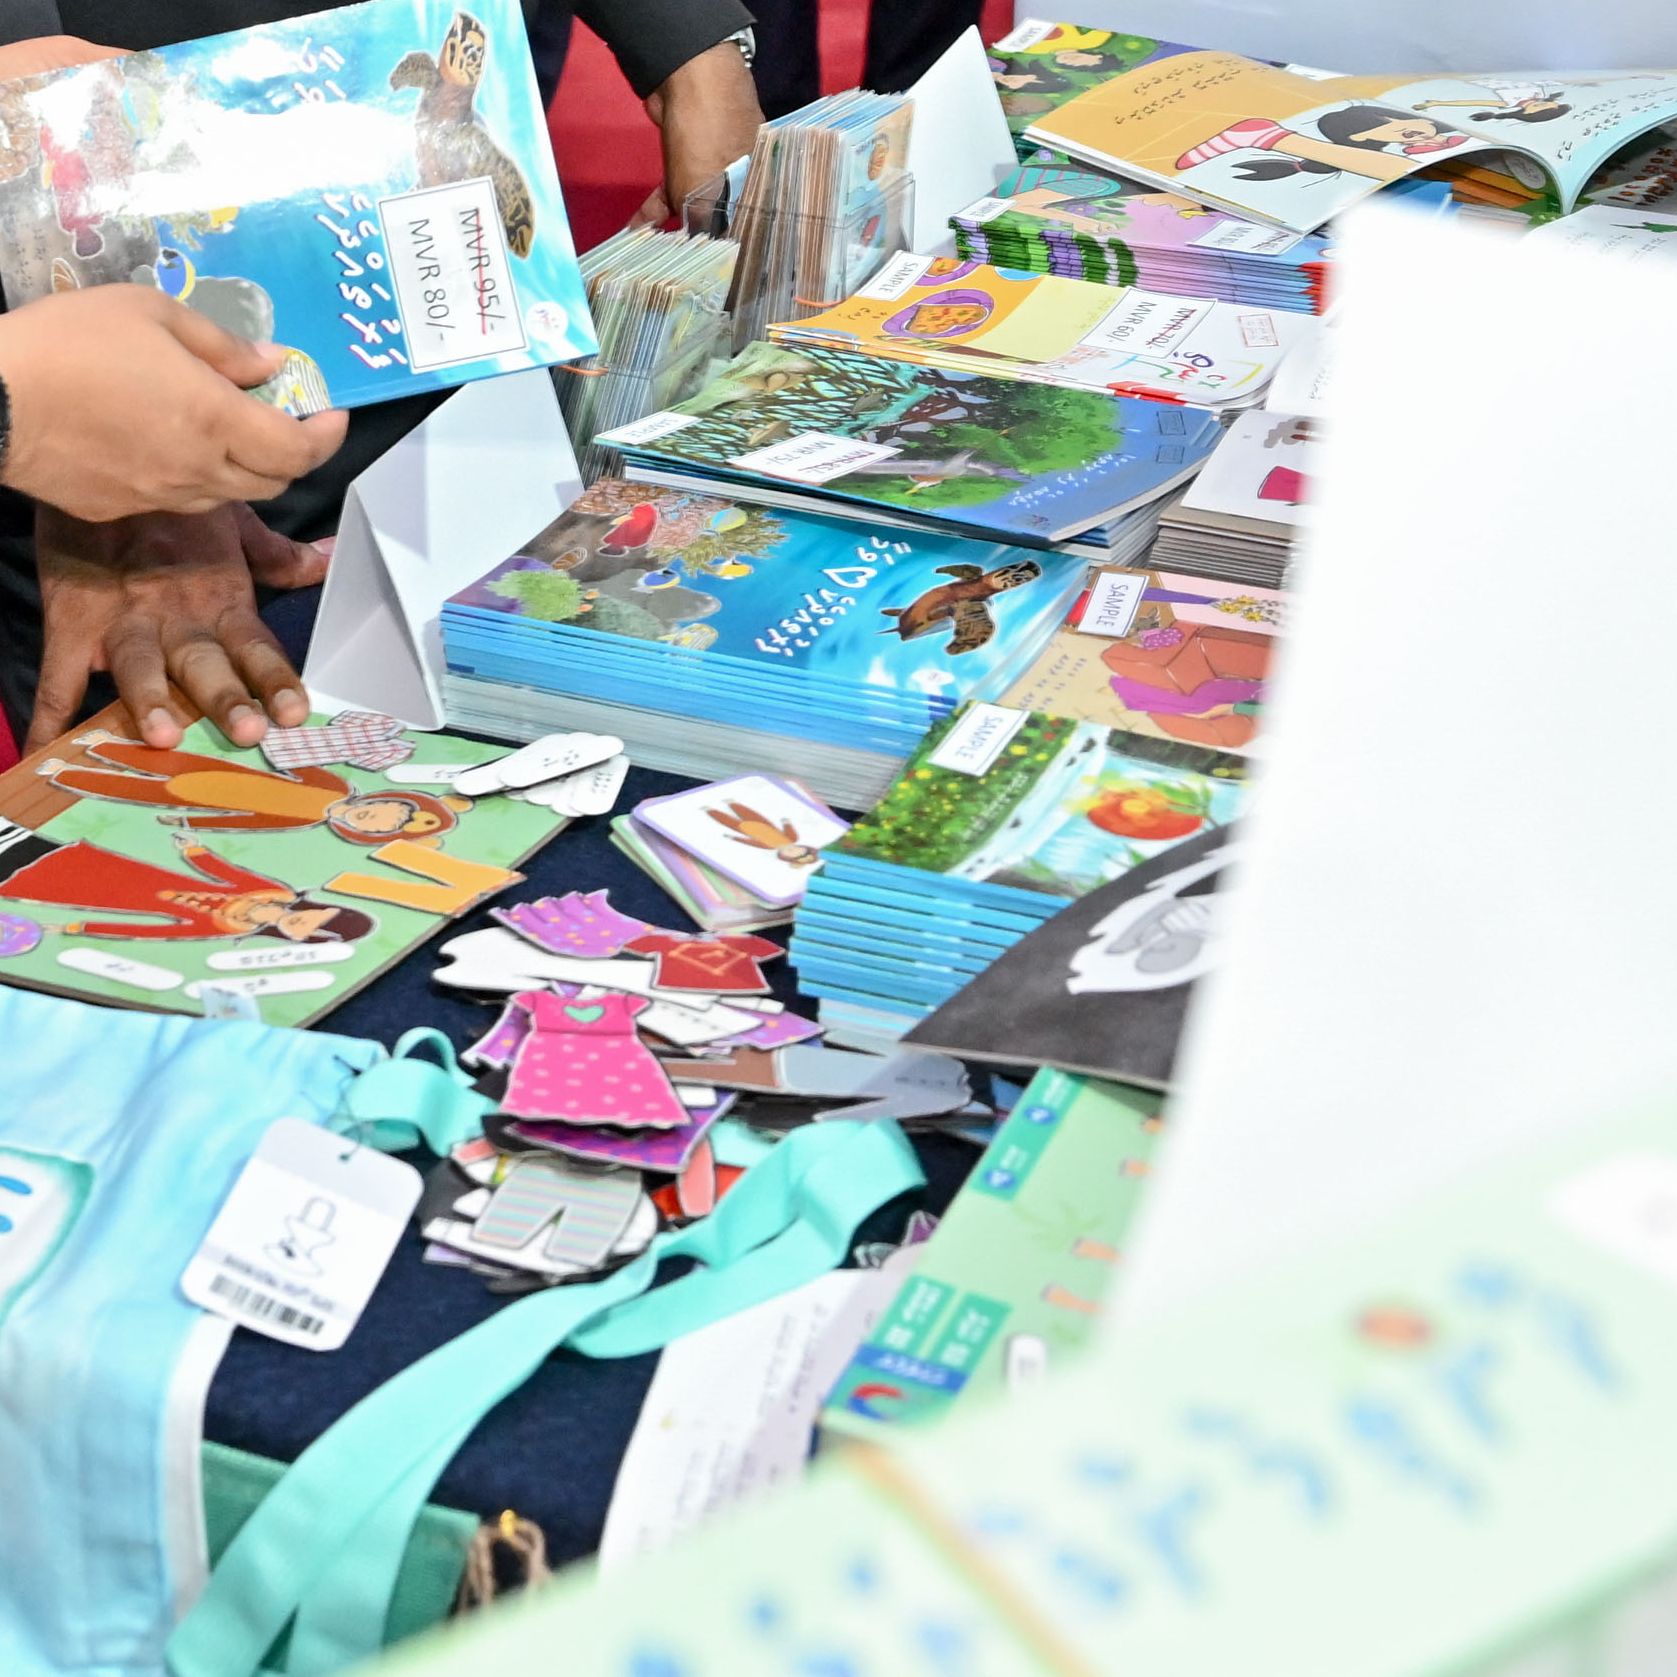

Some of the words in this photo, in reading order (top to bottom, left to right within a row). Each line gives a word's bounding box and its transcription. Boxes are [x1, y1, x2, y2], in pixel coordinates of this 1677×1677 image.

[408, 218, 442, 282] MVR
[458, 206, 492, 272] MVR
[878, 261, 919, 293] SAMPLE
[423, 288, 456, 342] 80/-
[473, 277, 507, 332] 95/-
[1123, 301, 1158, 331] MVR
[1169, 307, 1192, 332] MVR
[1107, 325, 1130, 343] 60/-
[1147, 332, 1175, 350] 70/-
[767, 452, 801, 466] 75/-
[801, 440, 836, 455] MVR
[1095, 582, 1129, 628] SAMPLE
[955, 715, 1004, 760] SAMPLE
